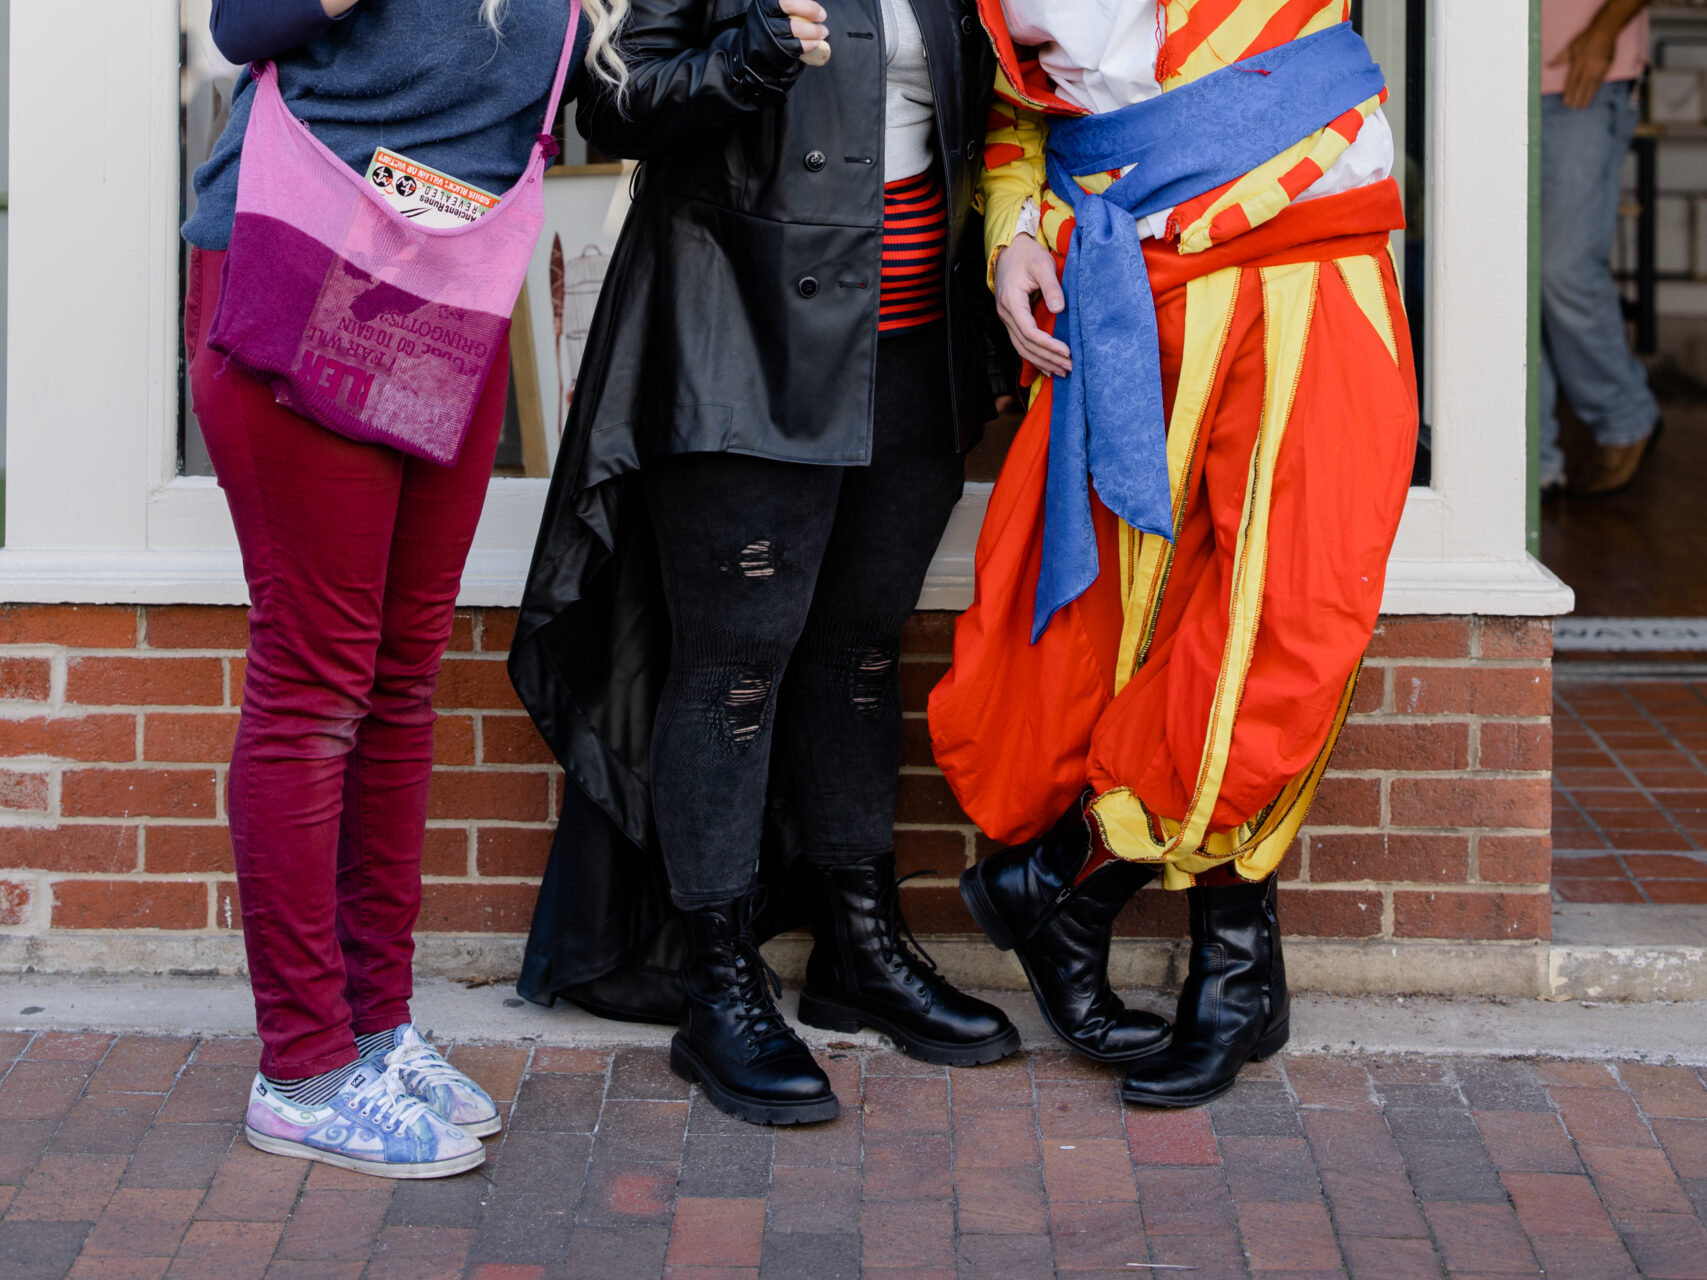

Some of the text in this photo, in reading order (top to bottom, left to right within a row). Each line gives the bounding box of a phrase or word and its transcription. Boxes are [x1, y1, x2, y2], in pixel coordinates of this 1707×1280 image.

[419, 194, 446, 211] Runes
[424, 185, 479, 214] REVEALED
[444, 203, 477, 222] Ancient
[337, 316, 376, 341] GAIN
[376, 328, 393, 348] TO
[346, 339, 385, 367] FAR
[396, 336, 416, 356] GO
